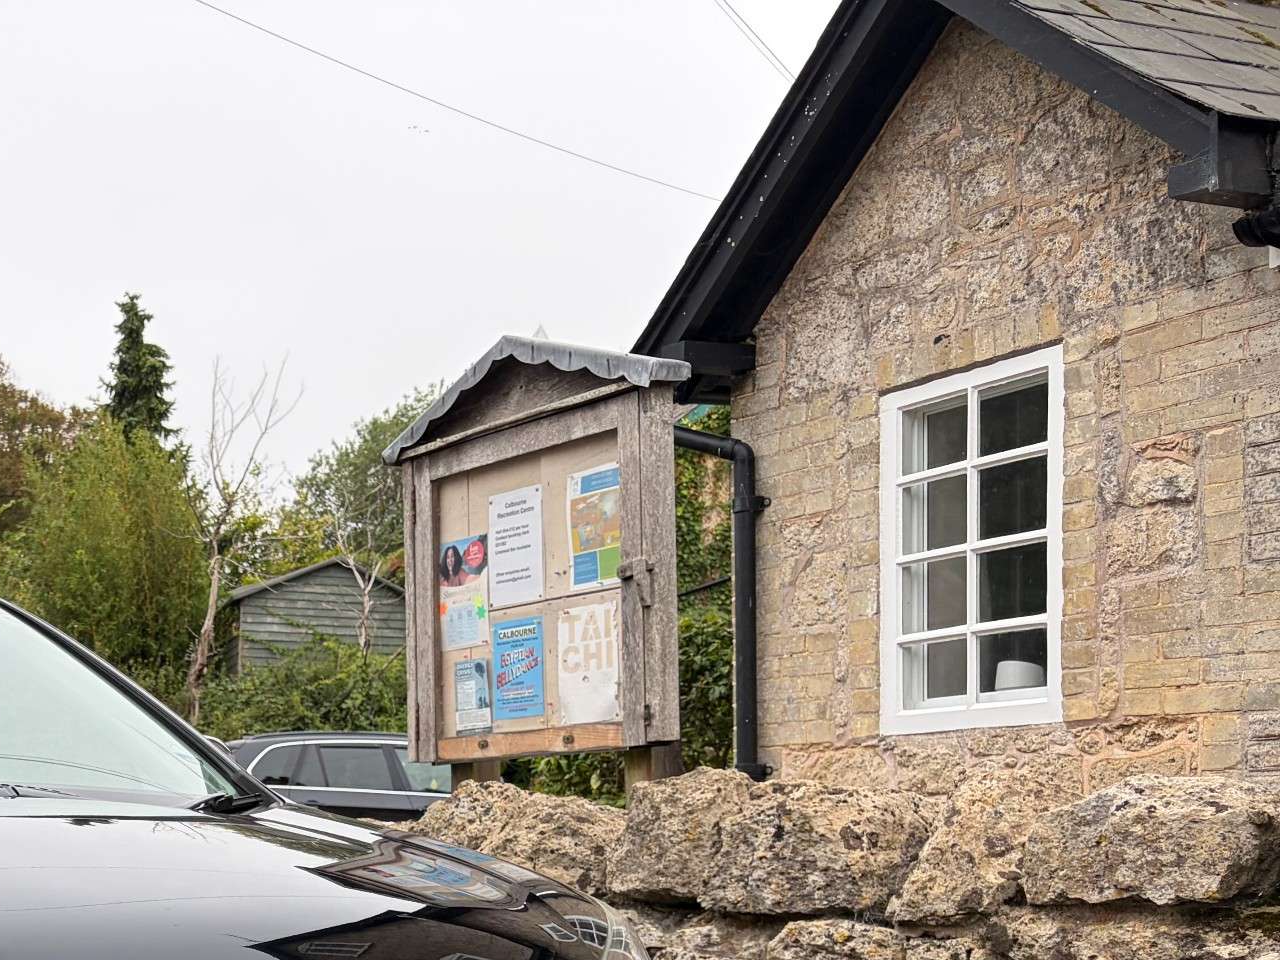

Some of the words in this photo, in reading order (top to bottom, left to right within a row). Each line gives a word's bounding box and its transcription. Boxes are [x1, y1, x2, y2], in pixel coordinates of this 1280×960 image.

[498, 627, 536, 640] CALBOURNE
[560, 608, 611, 644] TAI
[561, 640, 613, 673] CHI
